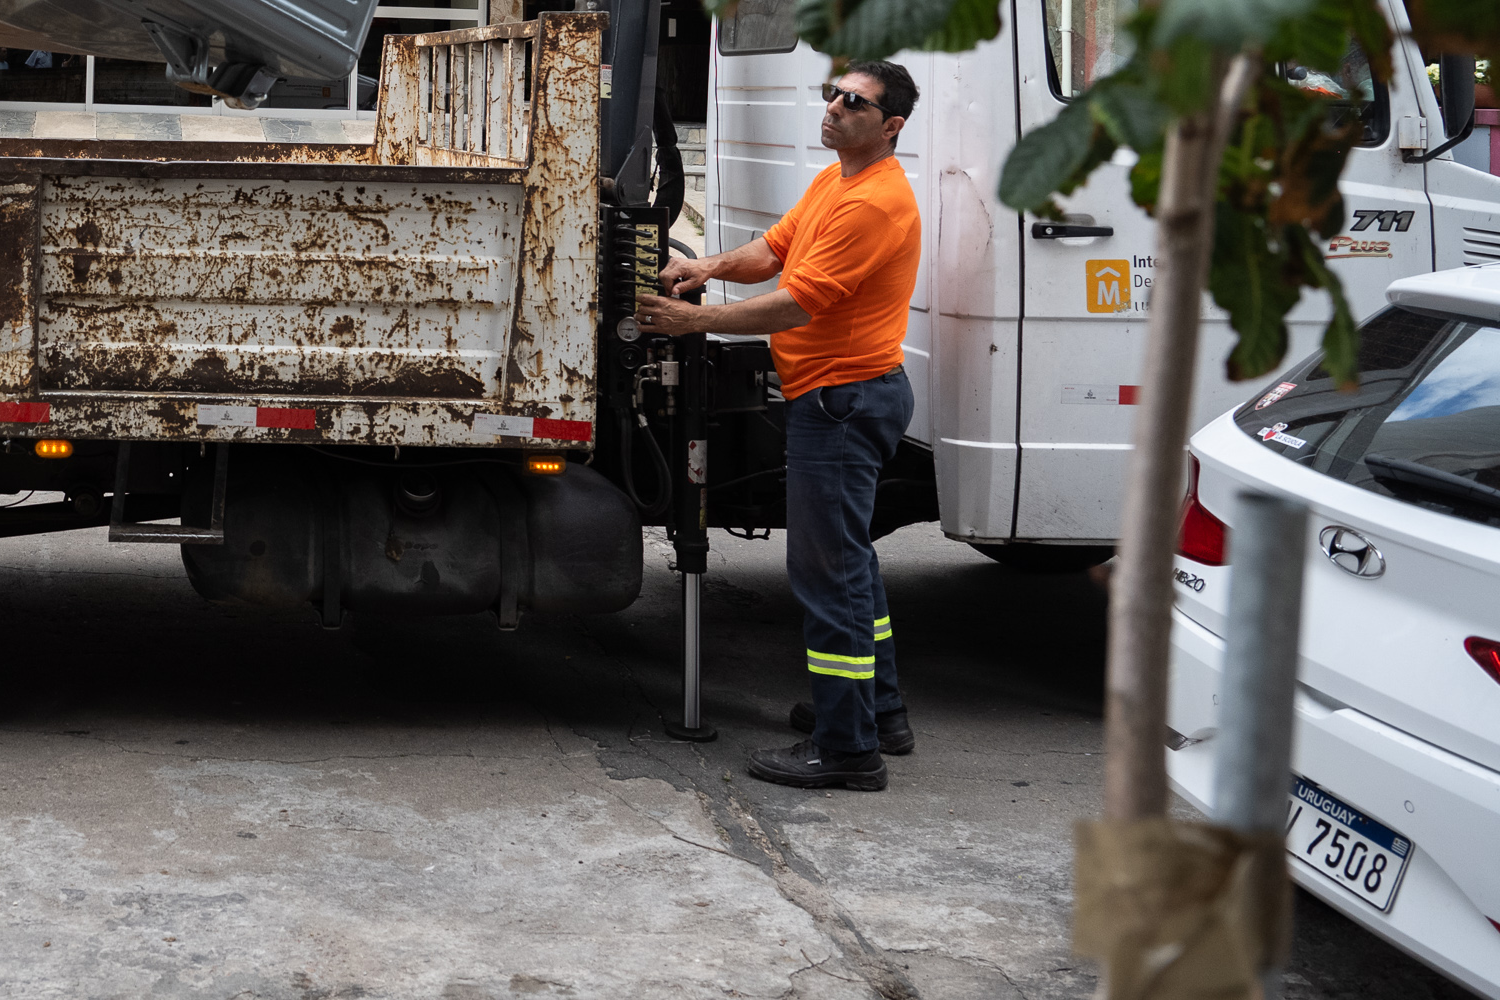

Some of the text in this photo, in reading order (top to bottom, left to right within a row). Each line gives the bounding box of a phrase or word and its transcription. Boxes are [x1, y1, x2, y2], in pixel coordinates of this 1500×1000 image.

[1350, 210, 1415, 232] 711
[1297, 784, 1357, 826] URUGUAY
[1306, 817, 1388, 894] 7508
